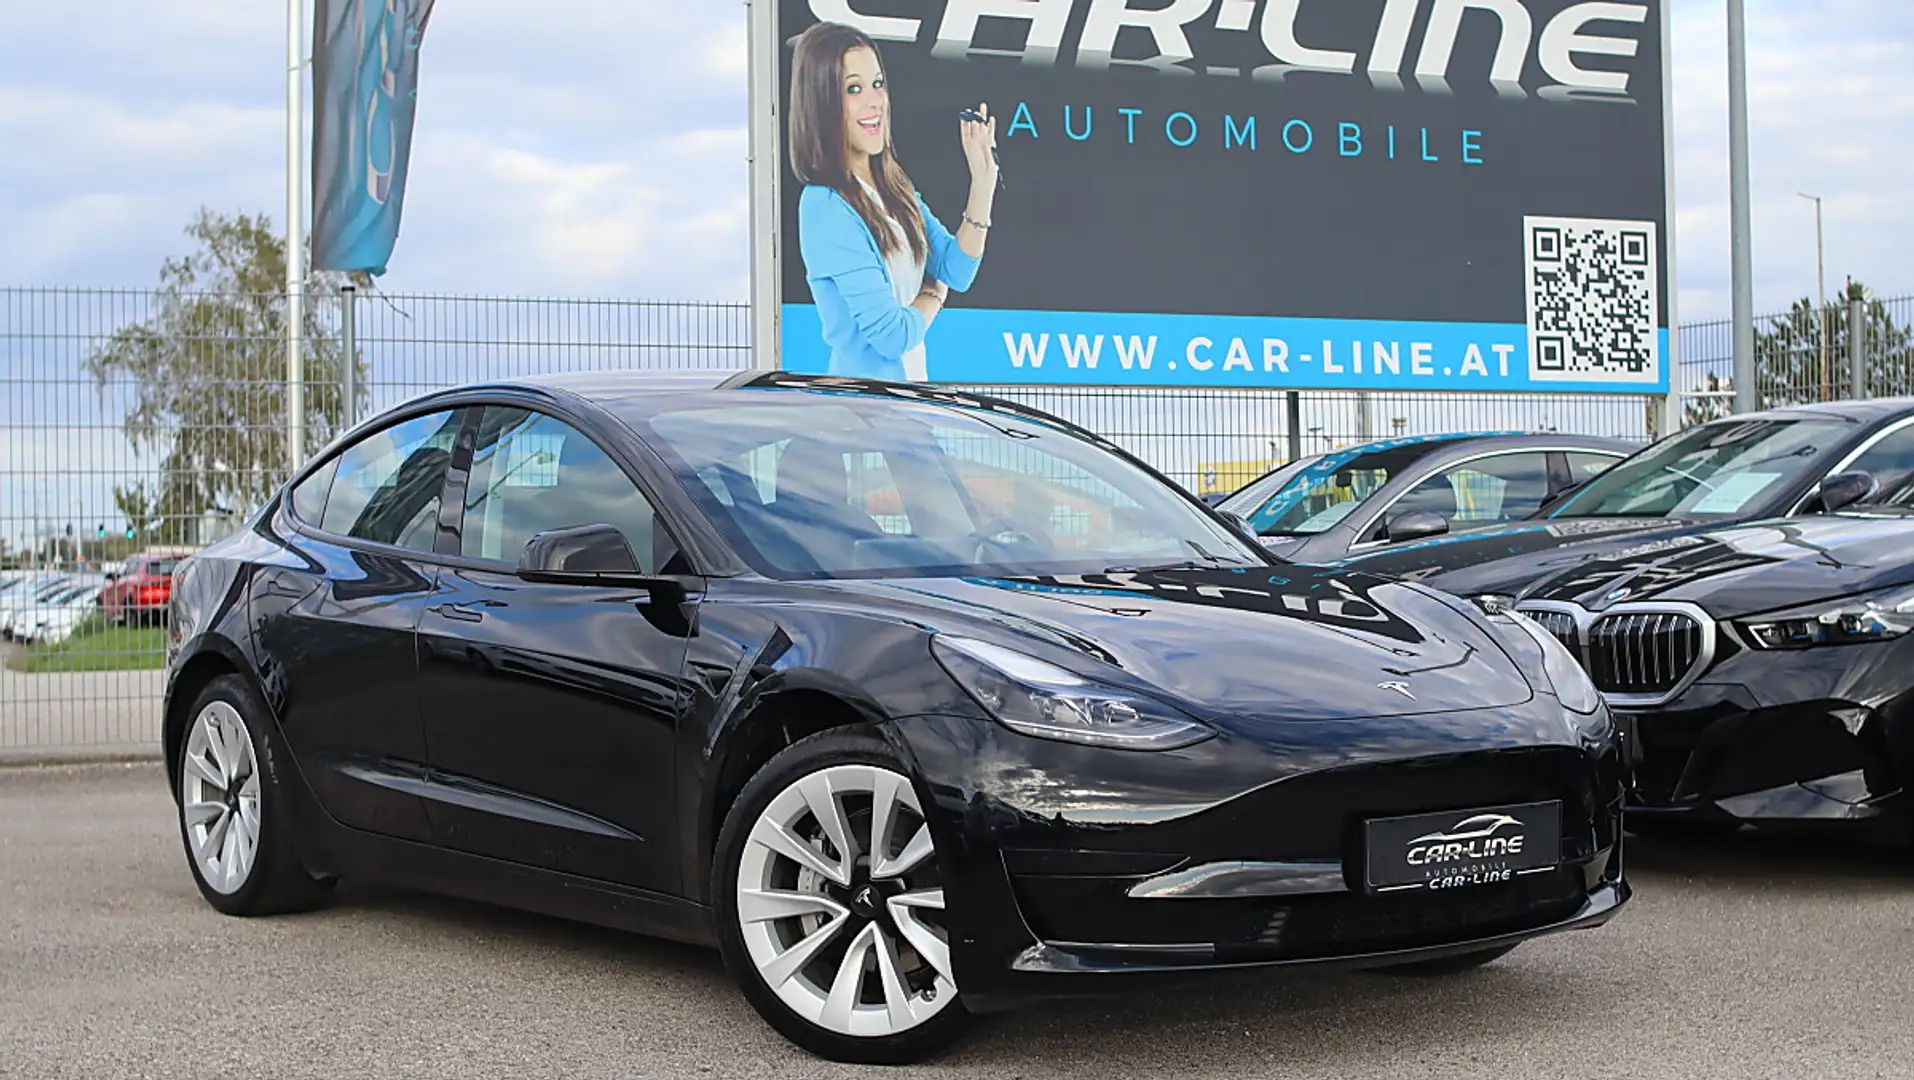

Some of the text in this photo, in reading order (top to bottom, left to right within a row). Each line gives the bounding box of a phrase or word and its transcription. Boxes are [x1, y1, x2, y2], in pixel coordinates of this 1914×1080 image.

[1007, 101, 1485, 165] AUTOMOBILE
[1003, 332, 1516, 377] WWW.CAR-LINE.AT
[1407, 835, 1524, 865] CAR-LINE
